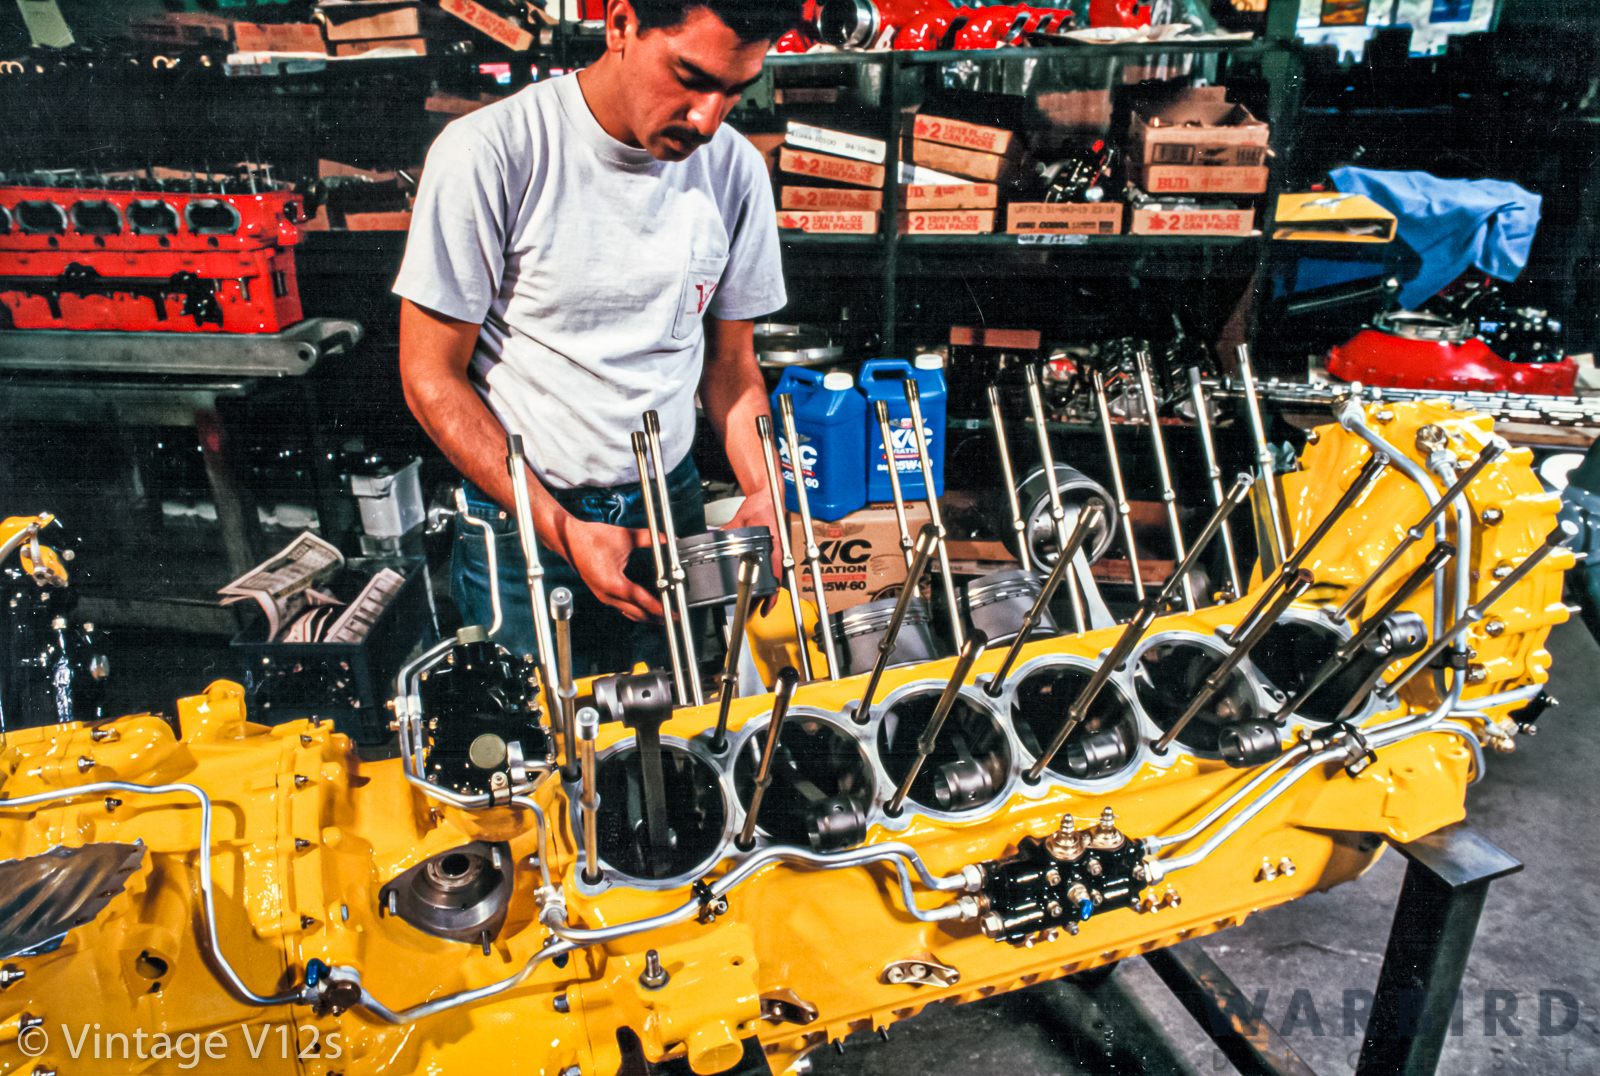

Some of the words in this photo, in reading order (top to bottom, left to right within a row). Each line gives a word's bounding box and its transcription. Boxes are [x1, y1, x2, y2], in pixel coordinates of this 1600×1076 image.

[930, 123, 941, 139] 2
[808, 159, 820, 174] 2
[807, 191, 817, 206] 2
[800, 215, 809, 230] 2
[812, 222, 830, 230] CAN
[833, 222, 863, 230] PACKS
[914, 215, 925, 230] 2
[949, 223, 979, 231] PACKS
[1169, 214, 1180, 230] 2
[1182, 222, 1204, 230] CAN
[1206, 222, 1240, 230] PACKS
[803, 565, 867, 574] AIATION
